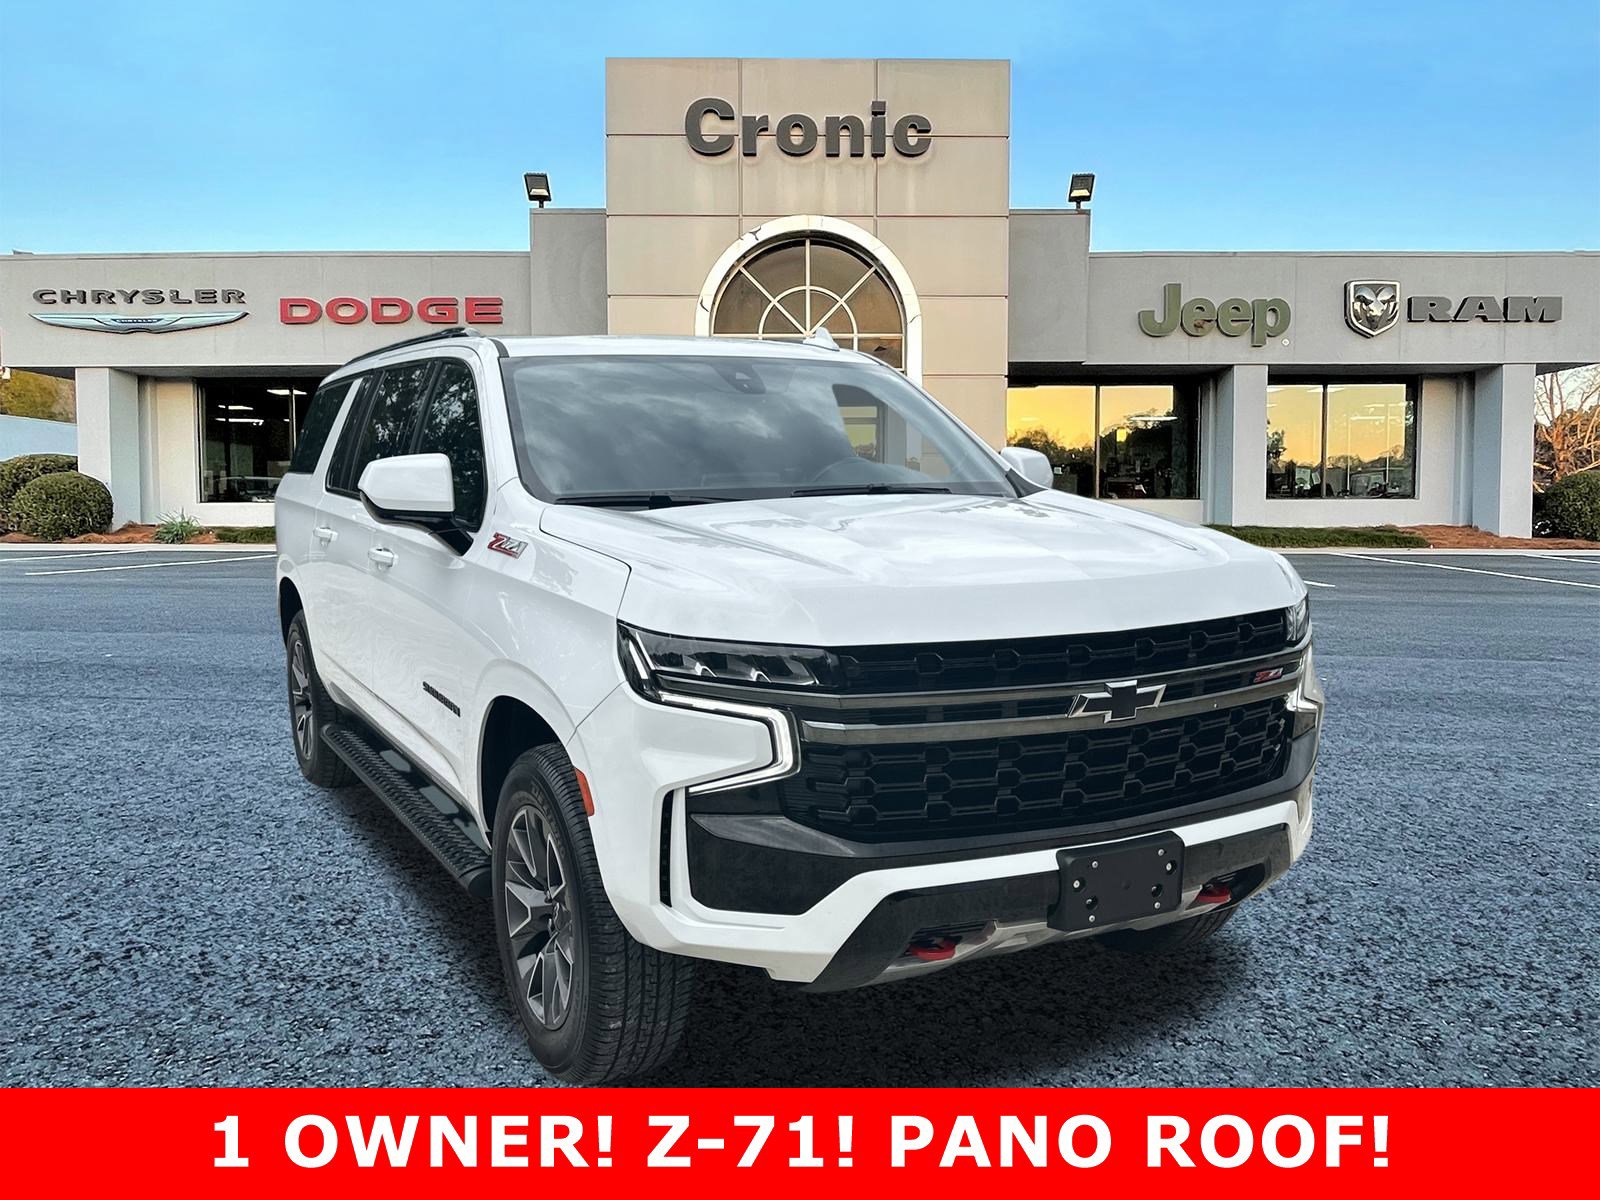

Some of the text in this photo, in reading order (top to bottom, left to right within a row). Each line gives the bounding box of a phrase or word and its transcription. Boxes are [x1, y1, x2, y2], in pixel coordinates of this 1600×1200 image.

[685, 97, 932, 157] Cronic
[33, 288, 247, 304] CHRYSLER
[1408, 296, 1562, 322] RAM
[279, 297, 504, 325] DODGE
[1138, 283, 1291, 346] Jeep
